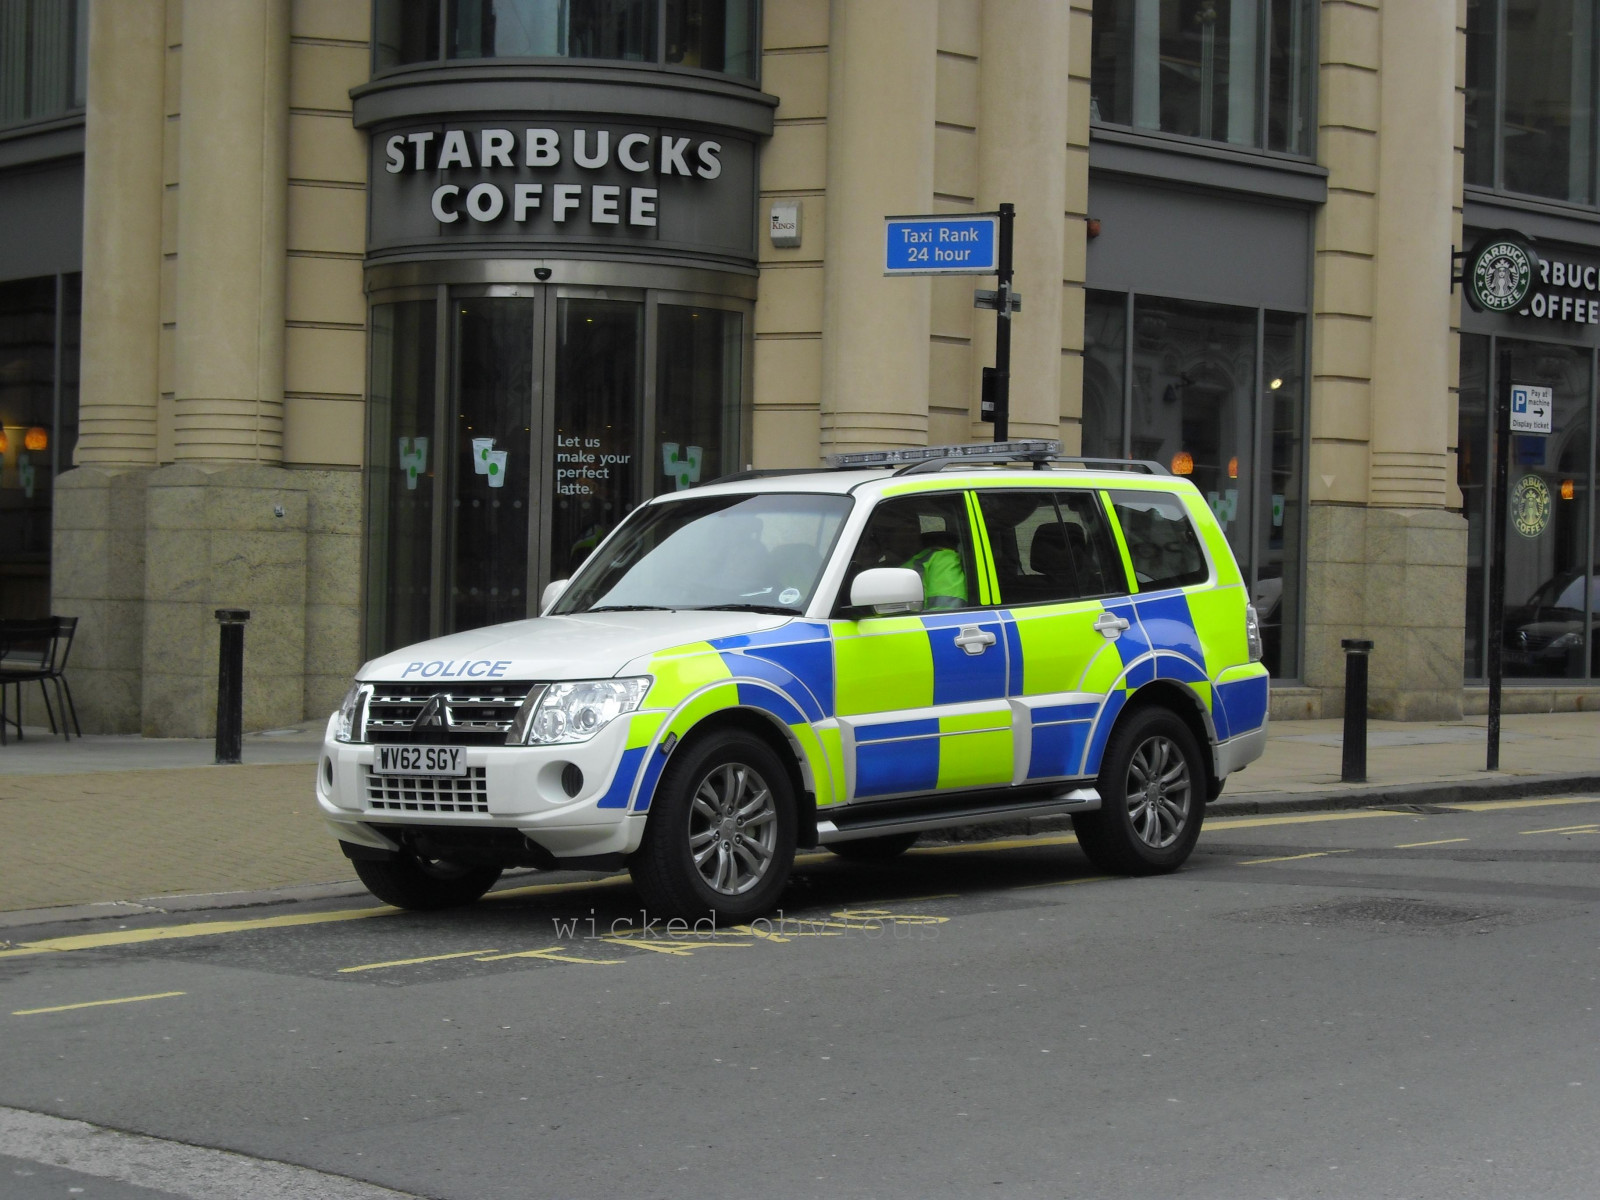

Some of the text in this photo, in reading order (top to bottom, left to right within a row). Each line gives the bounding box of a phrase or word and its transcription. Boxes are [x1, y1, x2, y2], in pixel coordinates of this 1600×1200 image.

[385, 128, 722, 180] STARBUCKS
[431, 182, 658, 226] COFFEE
[901, 227, 979, 244] Taxi Rank
[908, 246, 971, 262] 24 hour
[1477, 245, 1528, 276] STARBUCKS
[1481, 289, 1522, 308] COFFEE
[1519, 293, 1599, 324] OFFEE
[1515, 392, 1526, 412] P
[1531, 389, 1541, 398] Pay
[1528, 399, 1550, 407] machine
[1512, 419, 1550, 429] Display ticket
[557, 435, 600, 448] Let us
[557, 450, 631, 467] make your
[557, 466, 610, 480] perfect
[557, 480, 594, 495] latte.
[1512, 477, 1550, 505] STARBUCKS
[1516, 518, 1546, 535] COFFEE
[401, 660, 513, 679] POLICE
[380, 747, 459, 771] WV62 SGY
